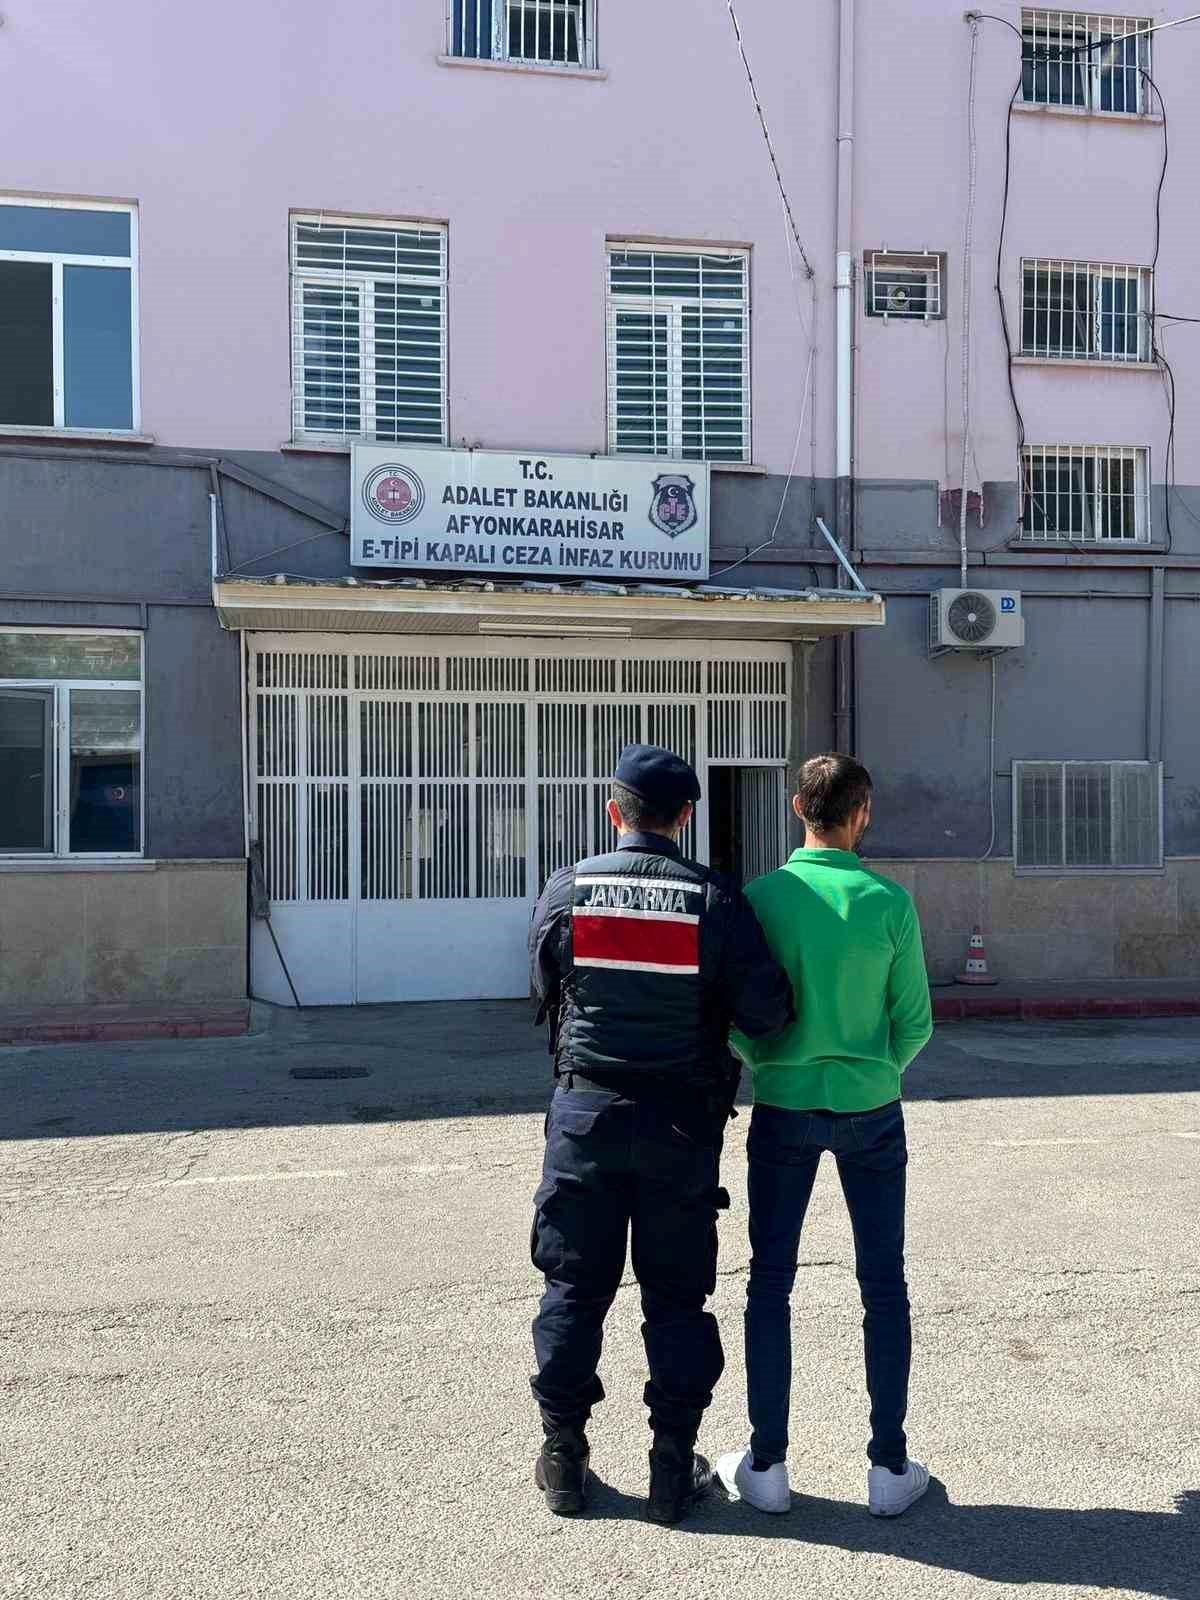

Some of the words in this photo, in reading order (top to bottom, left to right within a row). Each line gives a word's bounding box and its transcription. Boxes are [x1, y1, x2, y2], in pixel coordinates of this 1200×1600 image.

[519, 460, 554, 480] T.C.
[442, 485, 518, 507] ADALET
[524, 489, 628, 513] BAKANLIĞI
[446, 514, 625, 541] AFYONKARAHİSAR
[362, 536, 419, 561] E-TİPİ
[426, 541, 496, 564] KAPALI
[502, 545, 553, 567] CEZA
[559, 543, 614, 569] İNFAZ
[619, 550, 702, 572] KURUMU
[584, 885, 687, 913] JANDARMA
